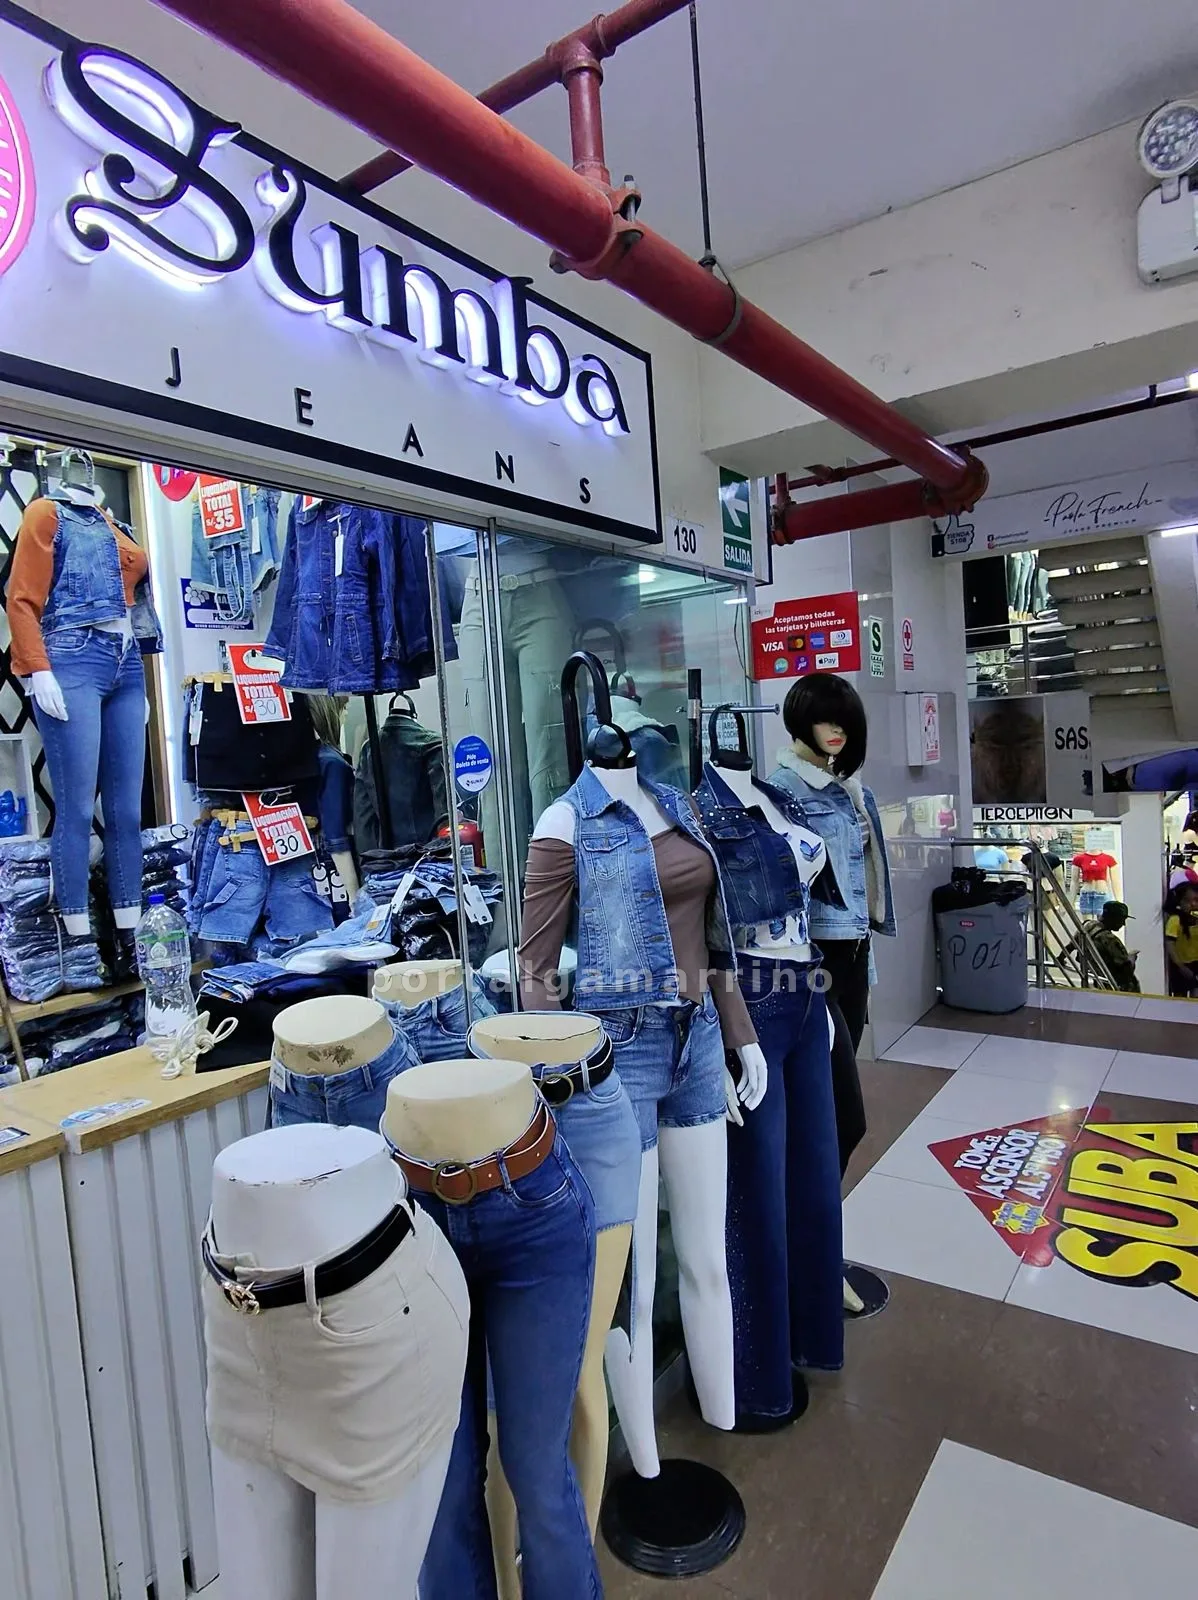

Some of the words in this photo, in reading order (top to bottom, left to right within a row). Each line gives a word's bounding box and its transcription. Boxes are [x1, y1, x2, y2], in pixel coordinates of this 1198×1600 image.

[60, 40, 632, 435] Sumba
[204, 493, 232, 512] TOTAL
[214, 507, 235, 530] 35
[674, 525, 697, 554] 130
[724, 544, 752, 566] SALIDA
[773, 613, 813, 625] Aceptamos
[814, 610, 836, 619] todas
[776, 622, 804, 633] tarjetas
[810, 618, 846, 629] billeteras
[761, 641, 785, 652] VISA
[872, 622, 882, 653] S
[823, 657, 837, 668] Pay
[242, 685, 279, 699] TOTAL
[254, 699, 278, 716] 30
[261, 820, 297, 840] TOTAL
[275, 834, 299, 855] 30
[953, 1138, 993, 1170] TOME
[1028, 1137, 1067, 1167] PISO
[975, 1128, 1041, 1199] ASCENSOR
[1013, 1179, 1049, 1201] AL
[1055, 1122, 1198, 1304] SUBA
